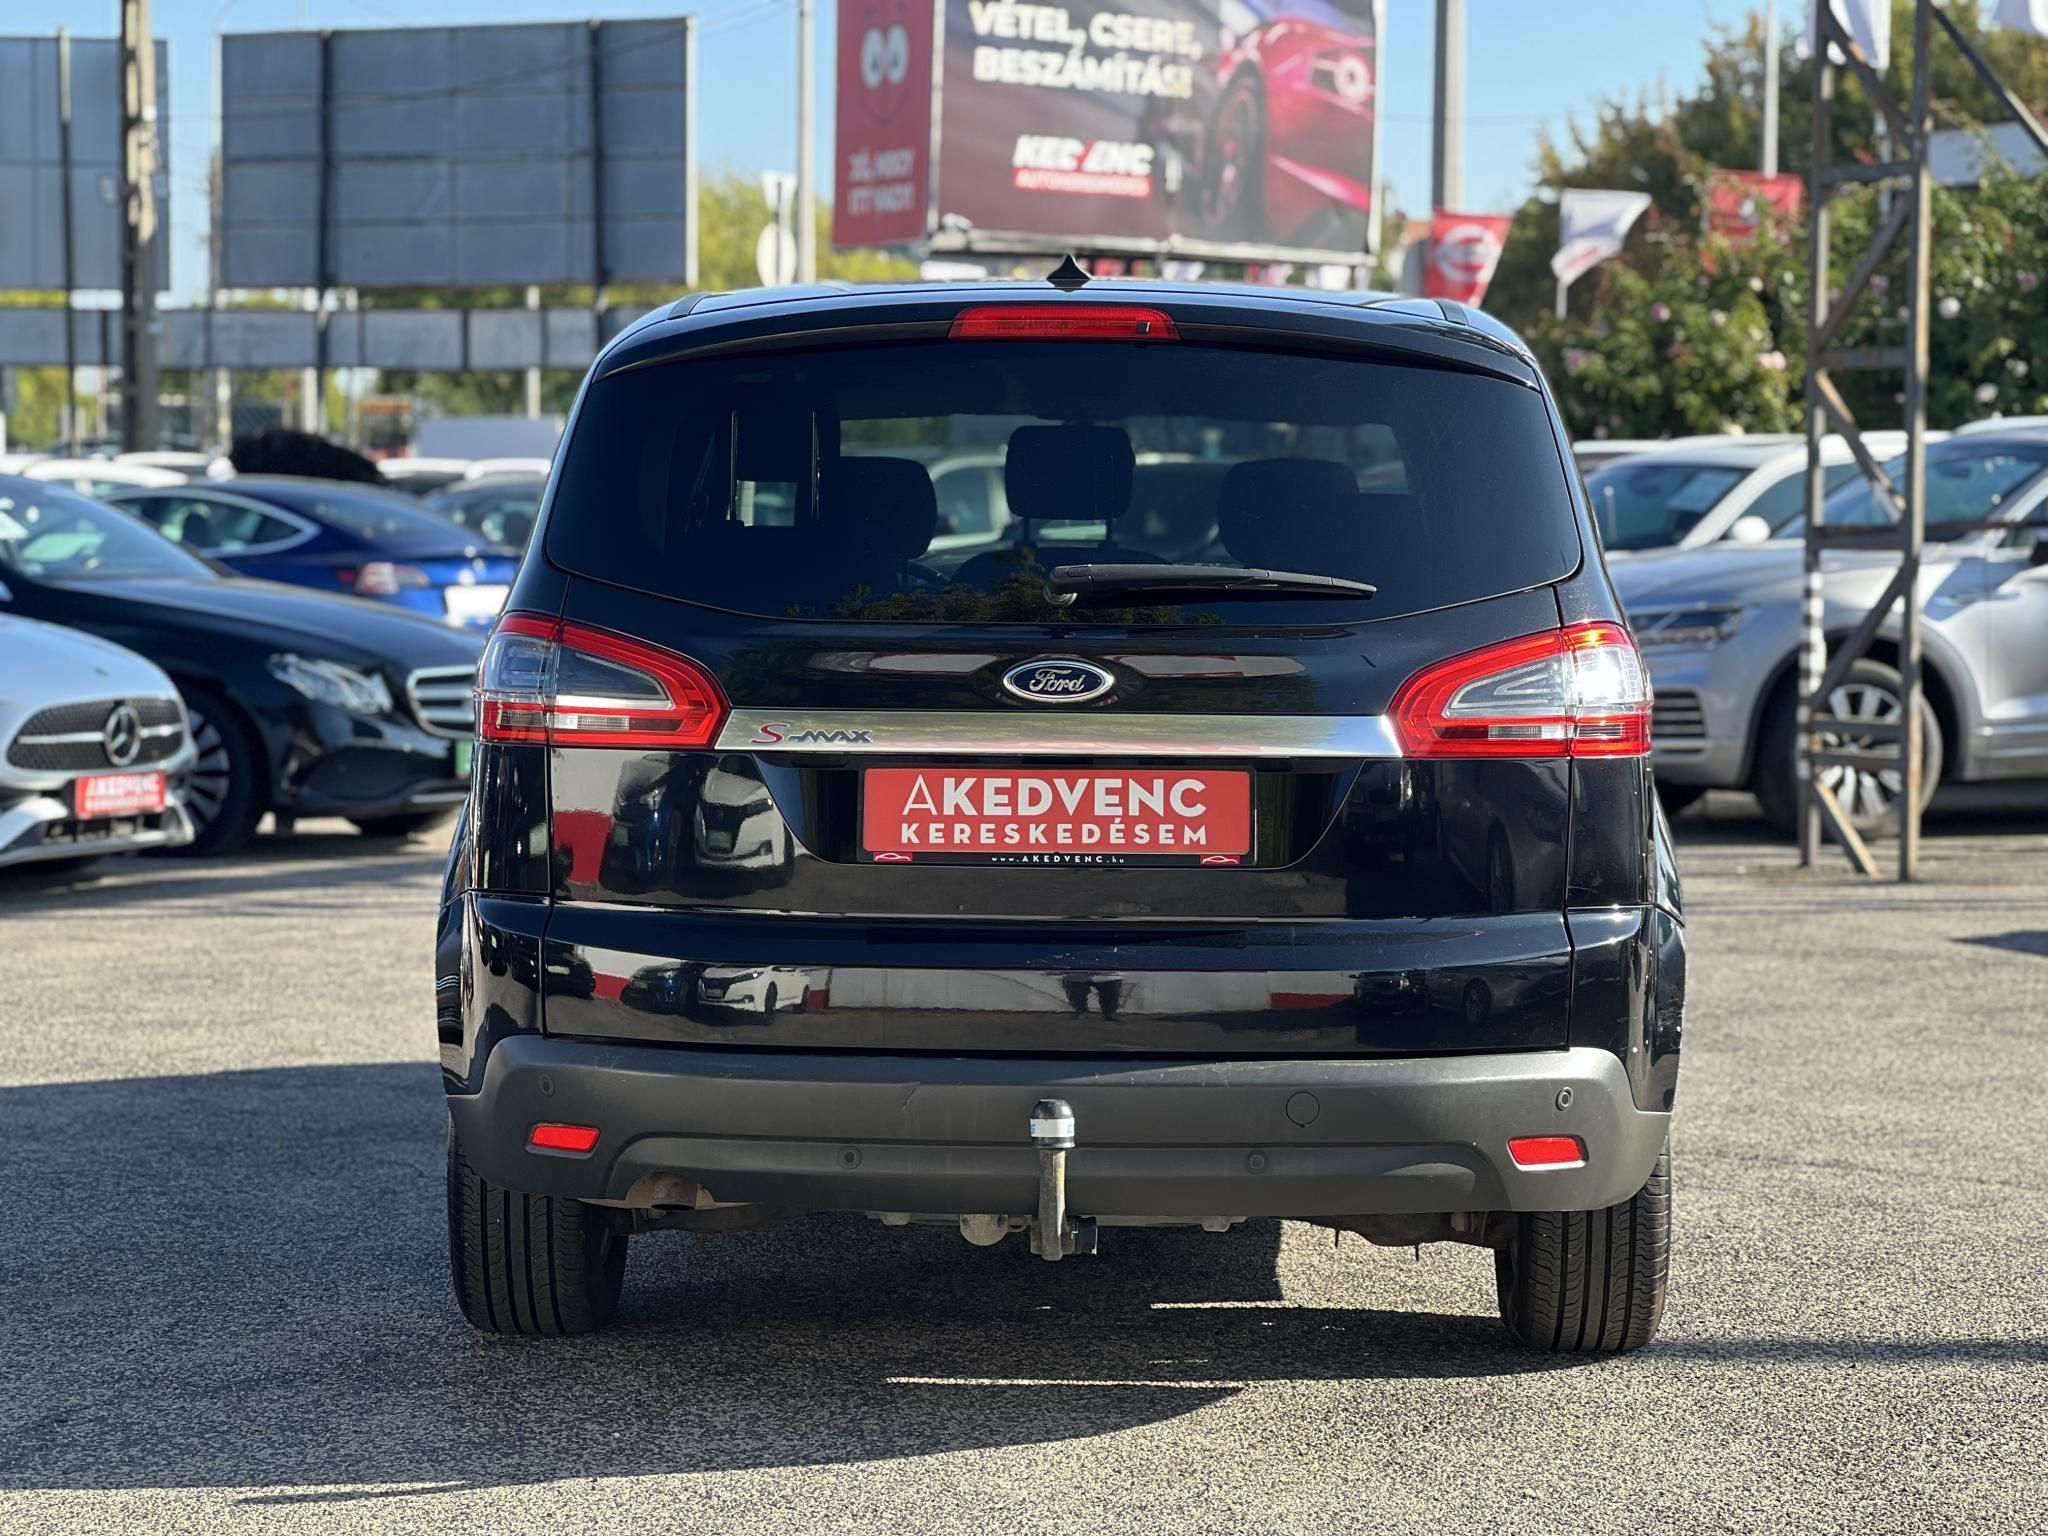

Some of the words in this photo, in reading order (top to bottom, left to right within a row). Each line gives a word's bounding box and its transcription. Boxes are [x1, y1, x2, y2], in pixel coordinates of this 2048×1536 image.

[968, 0, 1087, 48] VÉTEL,
[1089, 12, 1202, 61] CSERE,
[973, 46, 1192, 99] BESZÁMÍTÁS!
[1029, 668, 1086, 692] Ford
[902, 774, 1207, 818] AKEDVENC
[901, 818, 1207, 845] KERESKEDÉSEM
[991, 855, 1124, 863] www.AKEDVENC.hu
